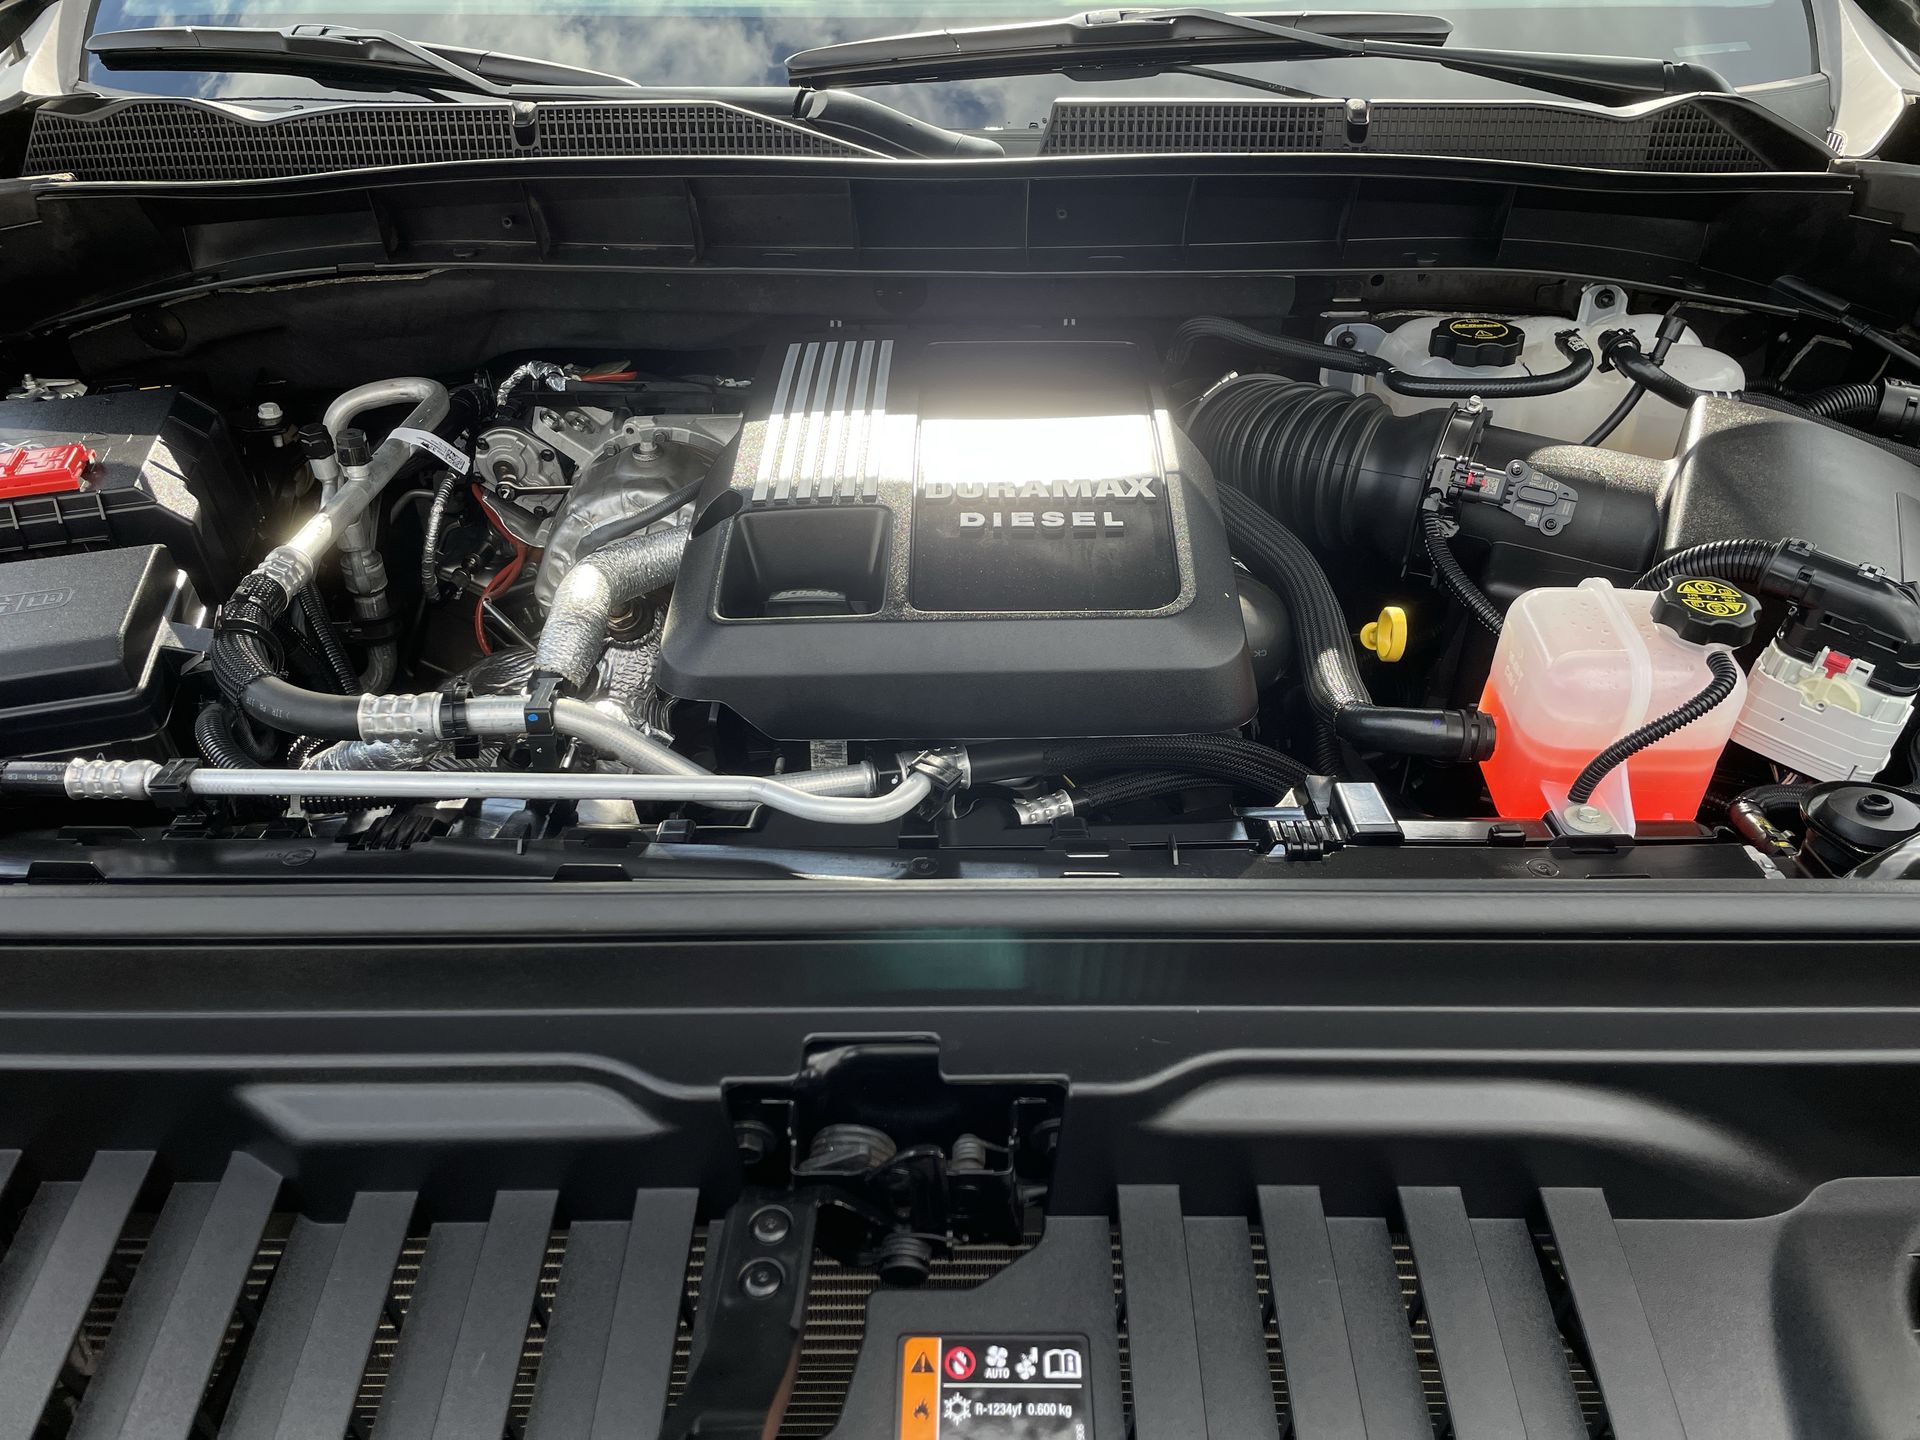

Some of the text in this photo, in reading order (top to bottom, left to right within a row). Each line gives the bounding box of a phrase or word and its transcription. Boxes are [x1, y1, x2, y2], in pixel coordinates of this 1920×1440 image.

[924, 477, 1157, 499] DURAMAX
[959, 511, 1125, 529] DIESEL
[984, 1367, 1010, 1379] AUTO
[975, 1402, 1073, 1418] R-1234yf 0.600 kg
